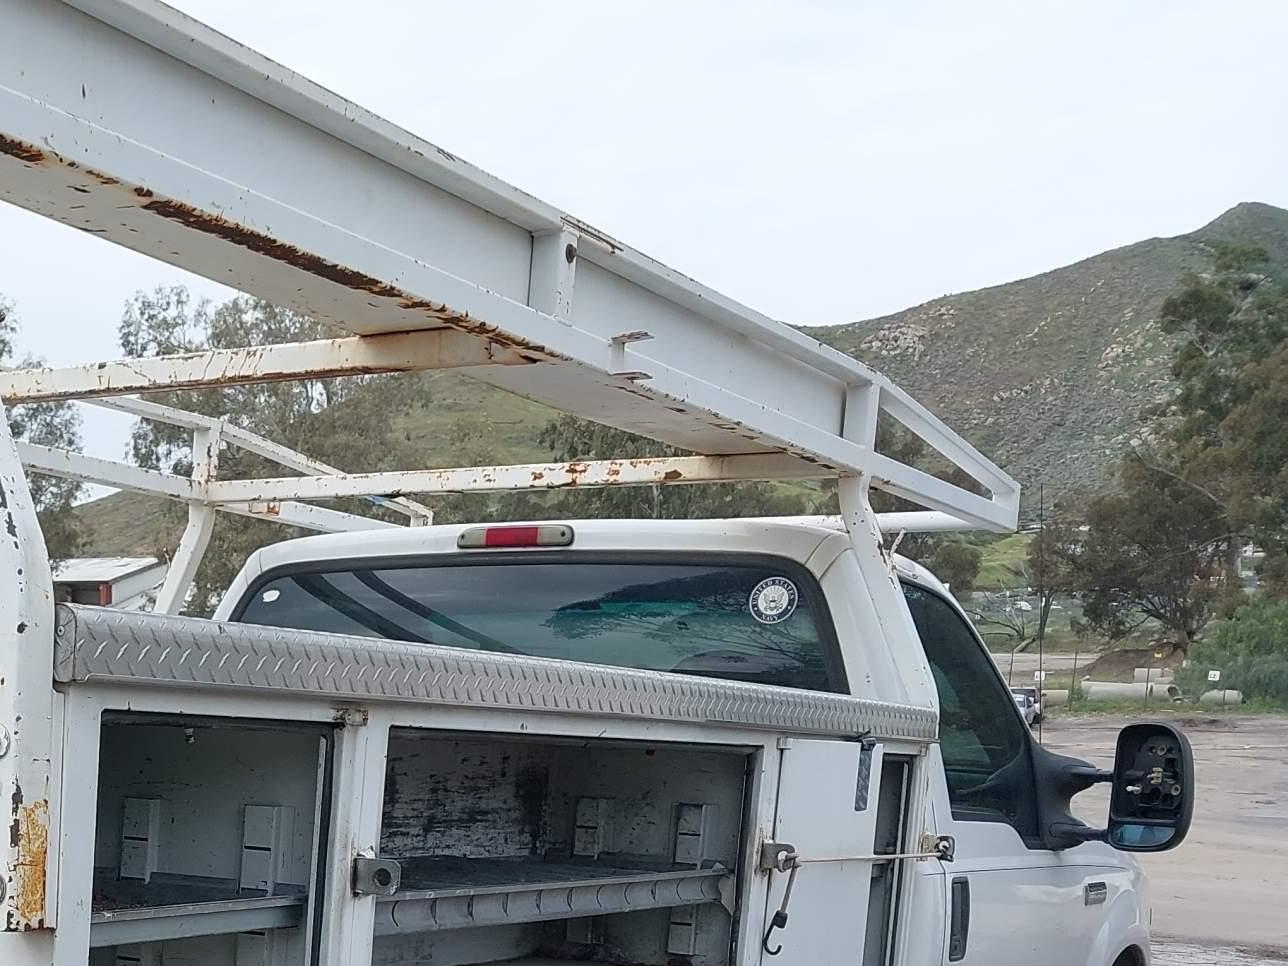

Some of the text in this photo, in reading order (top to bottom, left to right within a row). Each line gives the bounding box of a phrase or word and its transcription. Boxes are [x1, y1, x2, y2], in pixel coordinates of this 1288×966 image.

[752, 579, 795, 605] UNITED STATES
[760, 613, 779, 622] NAVY
